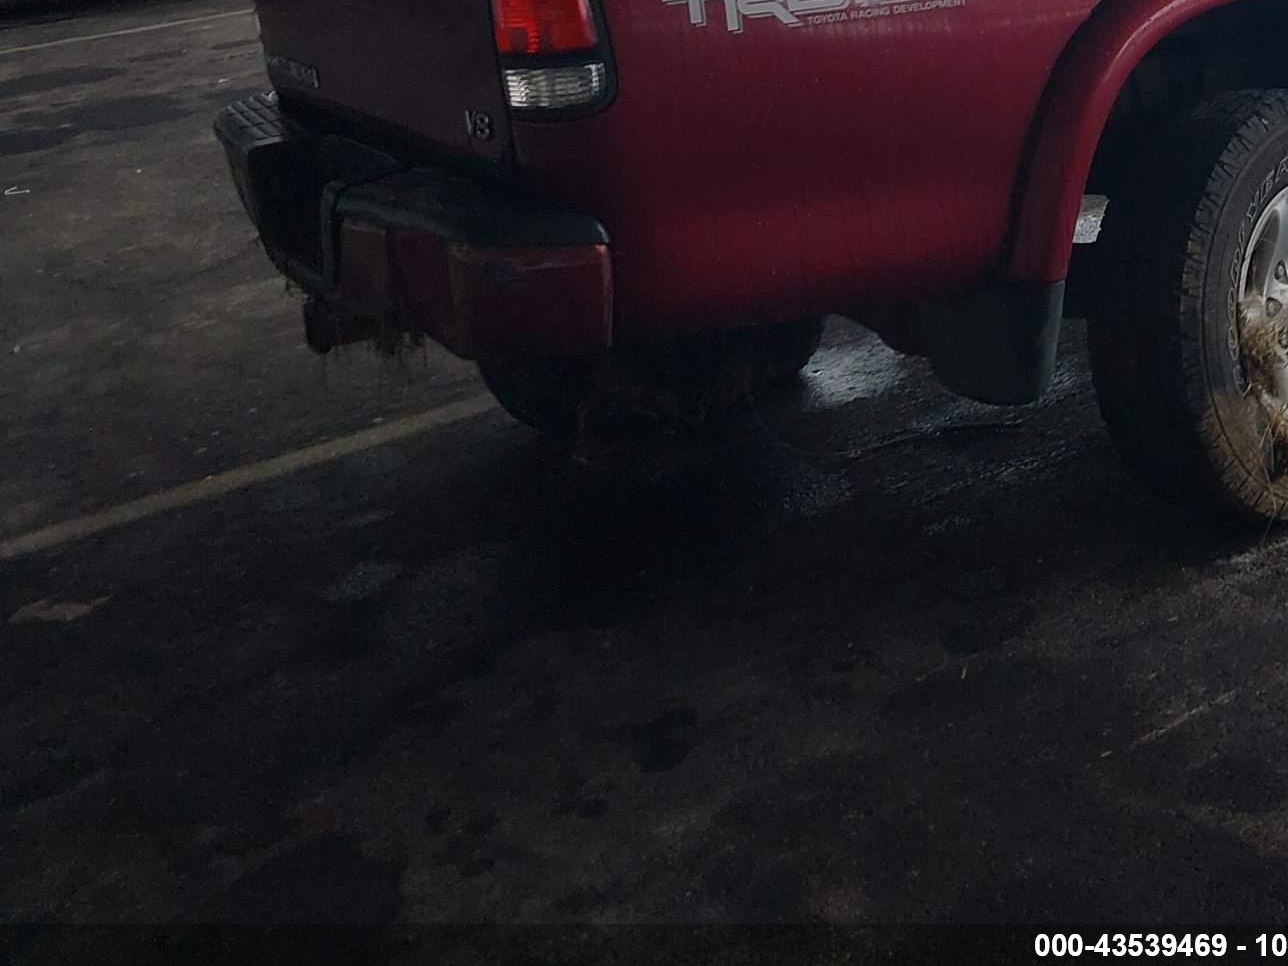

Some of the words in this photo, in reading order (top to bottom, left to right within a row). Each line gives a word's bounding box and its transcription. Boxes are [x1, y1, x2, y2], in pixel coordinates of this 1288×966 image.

[807, 12, 848, 26] TOYOTA
[850, 5, 890, 20] RACING
[464, 109, 491, 139] V8
